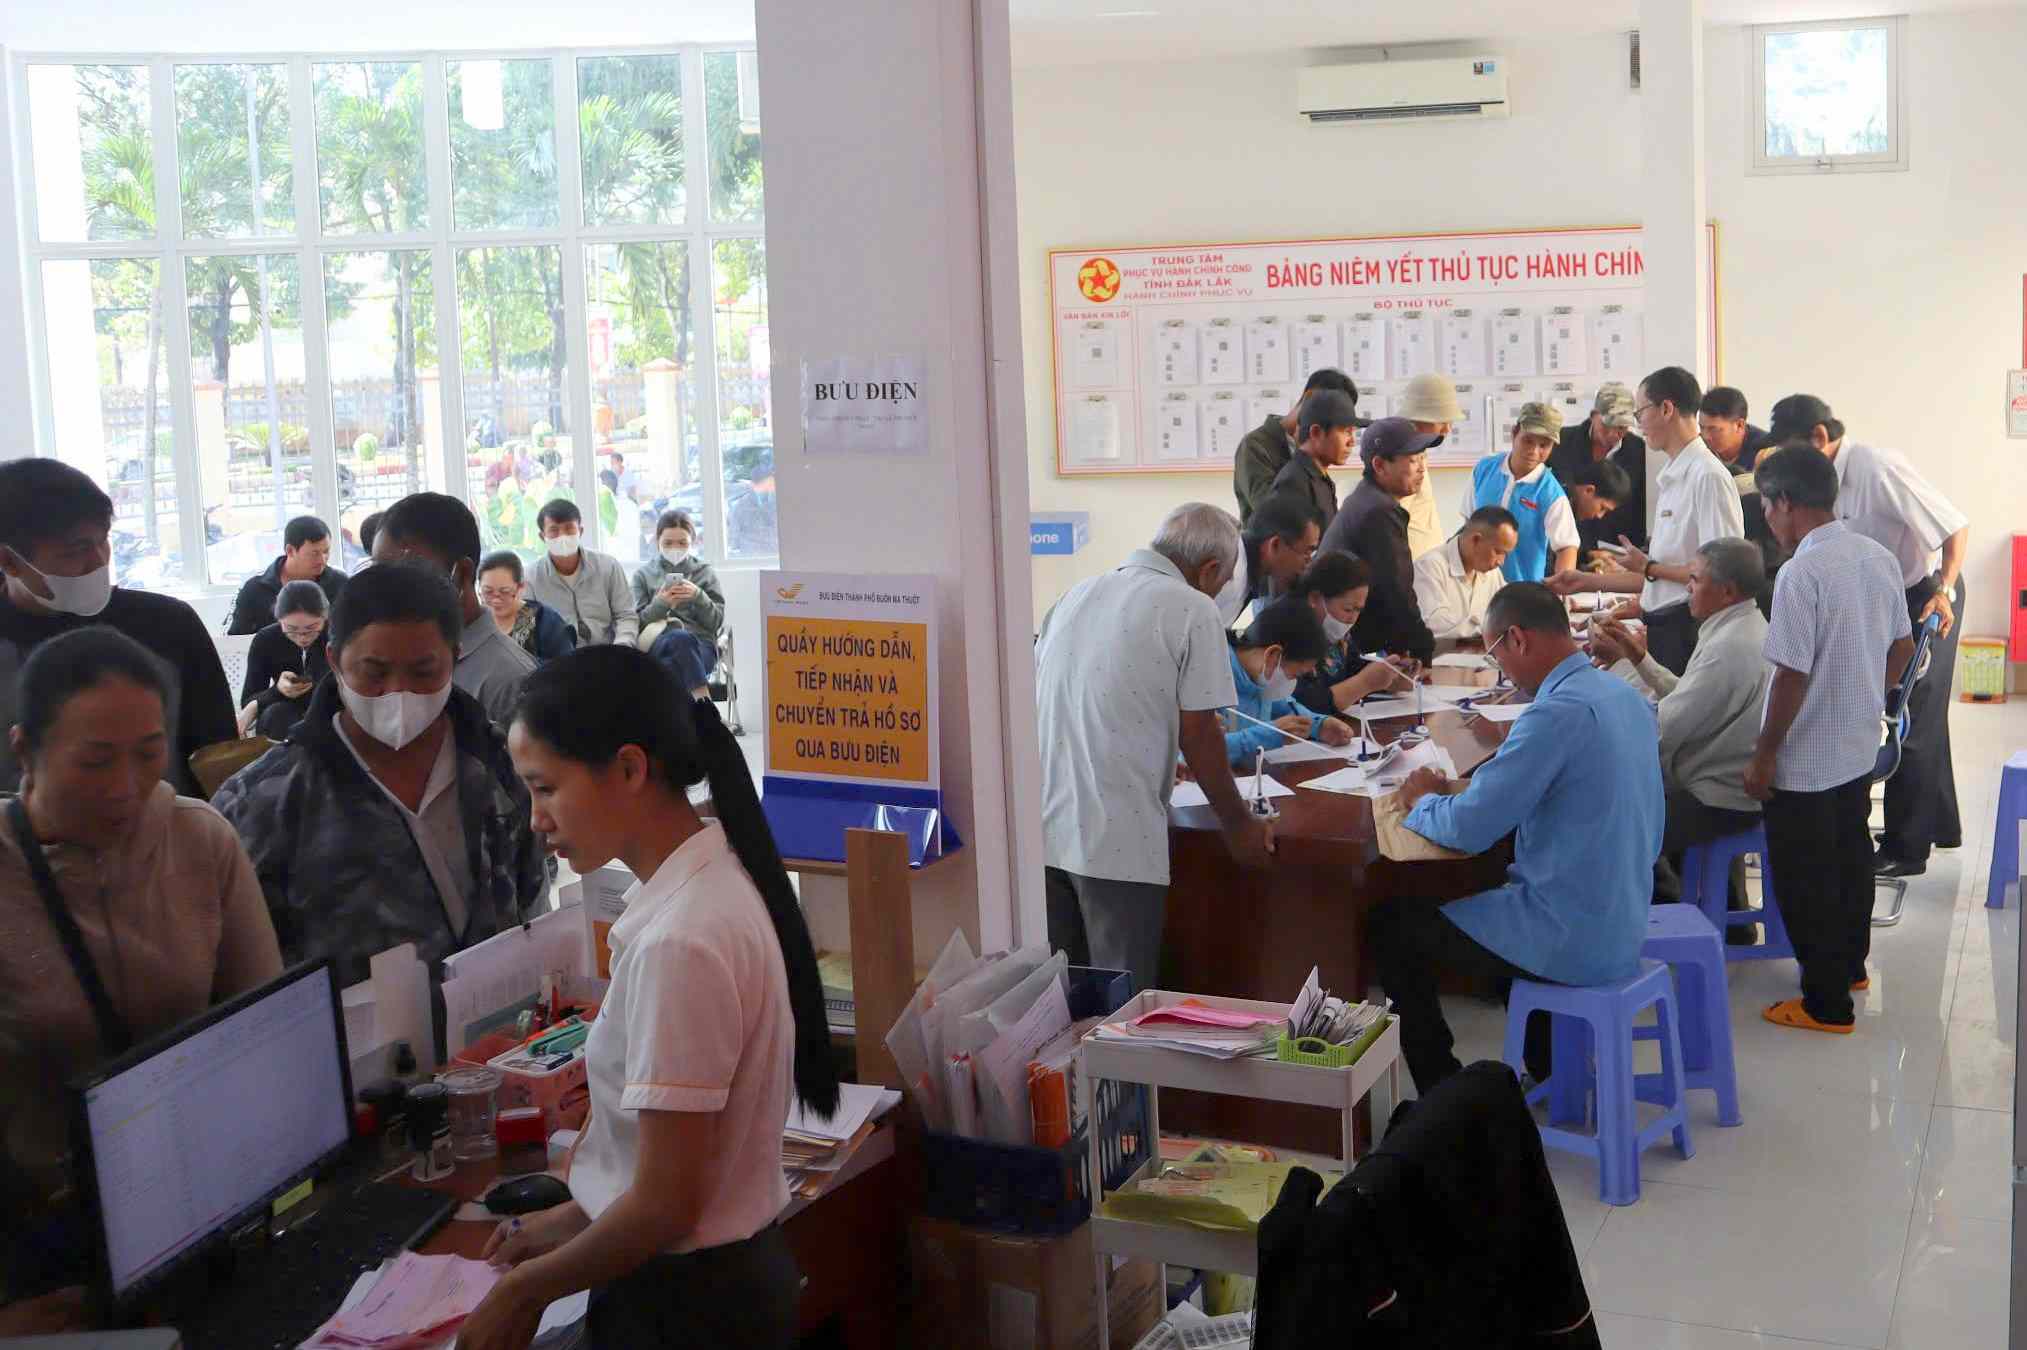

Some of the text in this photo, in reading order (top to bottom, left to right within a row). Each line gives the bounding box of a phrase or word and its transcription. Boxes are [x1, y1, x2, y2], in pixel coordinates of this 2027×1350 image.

[1152, 254, 1223, 266] TRUNG TÂM
[1266, 257, 1323, 288] BẢNG
[1330, 256, 1380, 286] NIÊM
[1387, 251, 1423, 283] YẾT
[1429, 250, 1470, 282] THỦ
[1477, 255, 1518, 286] TỤC
[1527, 248, 1587, 279] HÀNH
[815, 380, 858, 400] BƯU
[823, 631, 875, 657] HƯỚNG
[880, 631, 916, 663] DẪN,
[795, 664, 898, 696] TIẾP NHẬN VÀ
[776, 696, 836, 726] CHUYỂN
[840, 702, 870, 729] TRẢ
[900, 709, 921, 732] SƠ
[795, 738, 900, 768] QUA BƯU ĐIỆN
